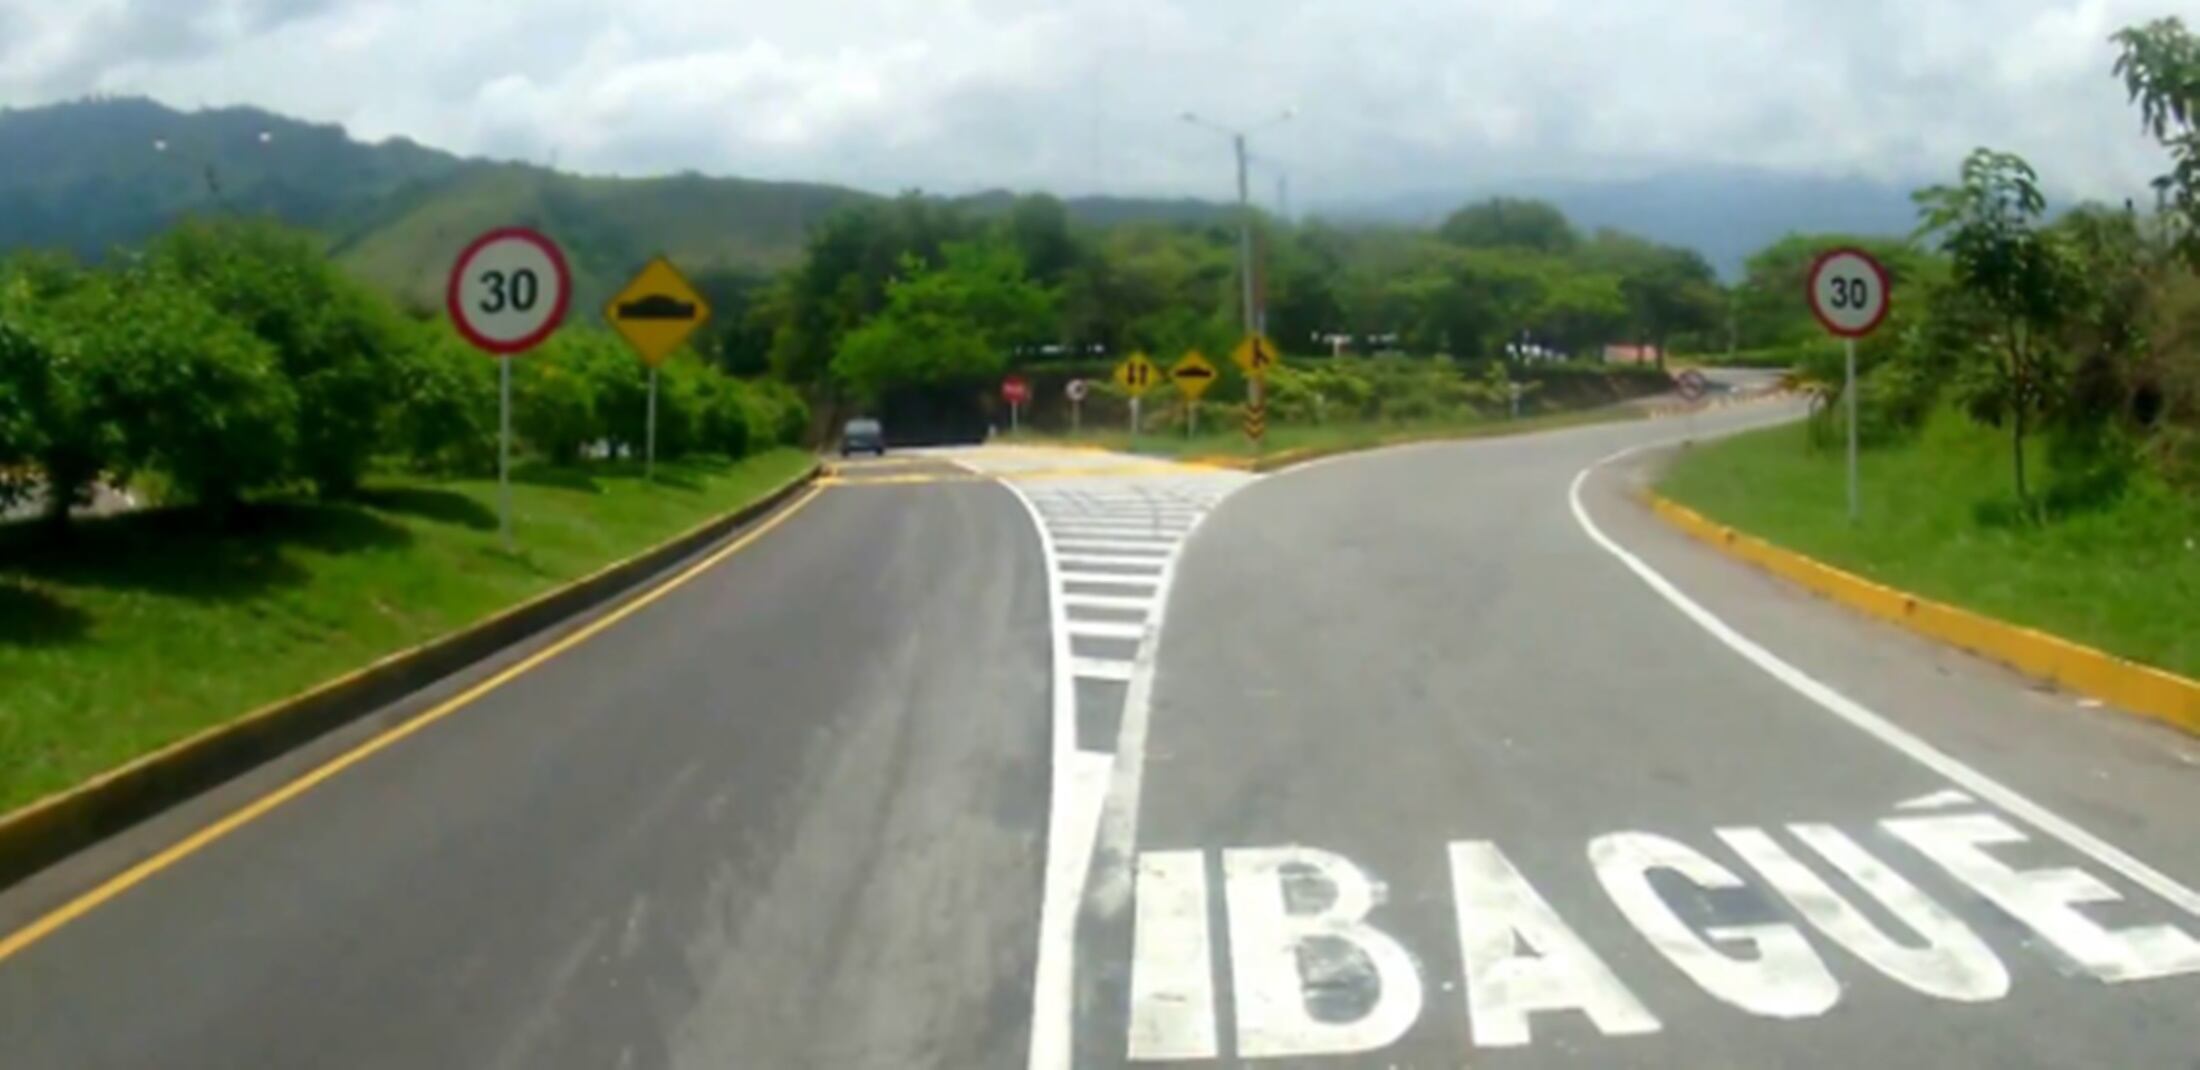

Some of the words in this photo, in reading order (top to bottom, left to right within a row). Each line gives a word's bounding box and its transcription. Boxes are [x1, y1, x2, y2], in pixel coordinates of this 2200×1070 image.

[479, 268, 538, 314] 30
[1831, 276, 1867, 310] 30
[1127, 790, 2200, 1060] IBAGUÉ
